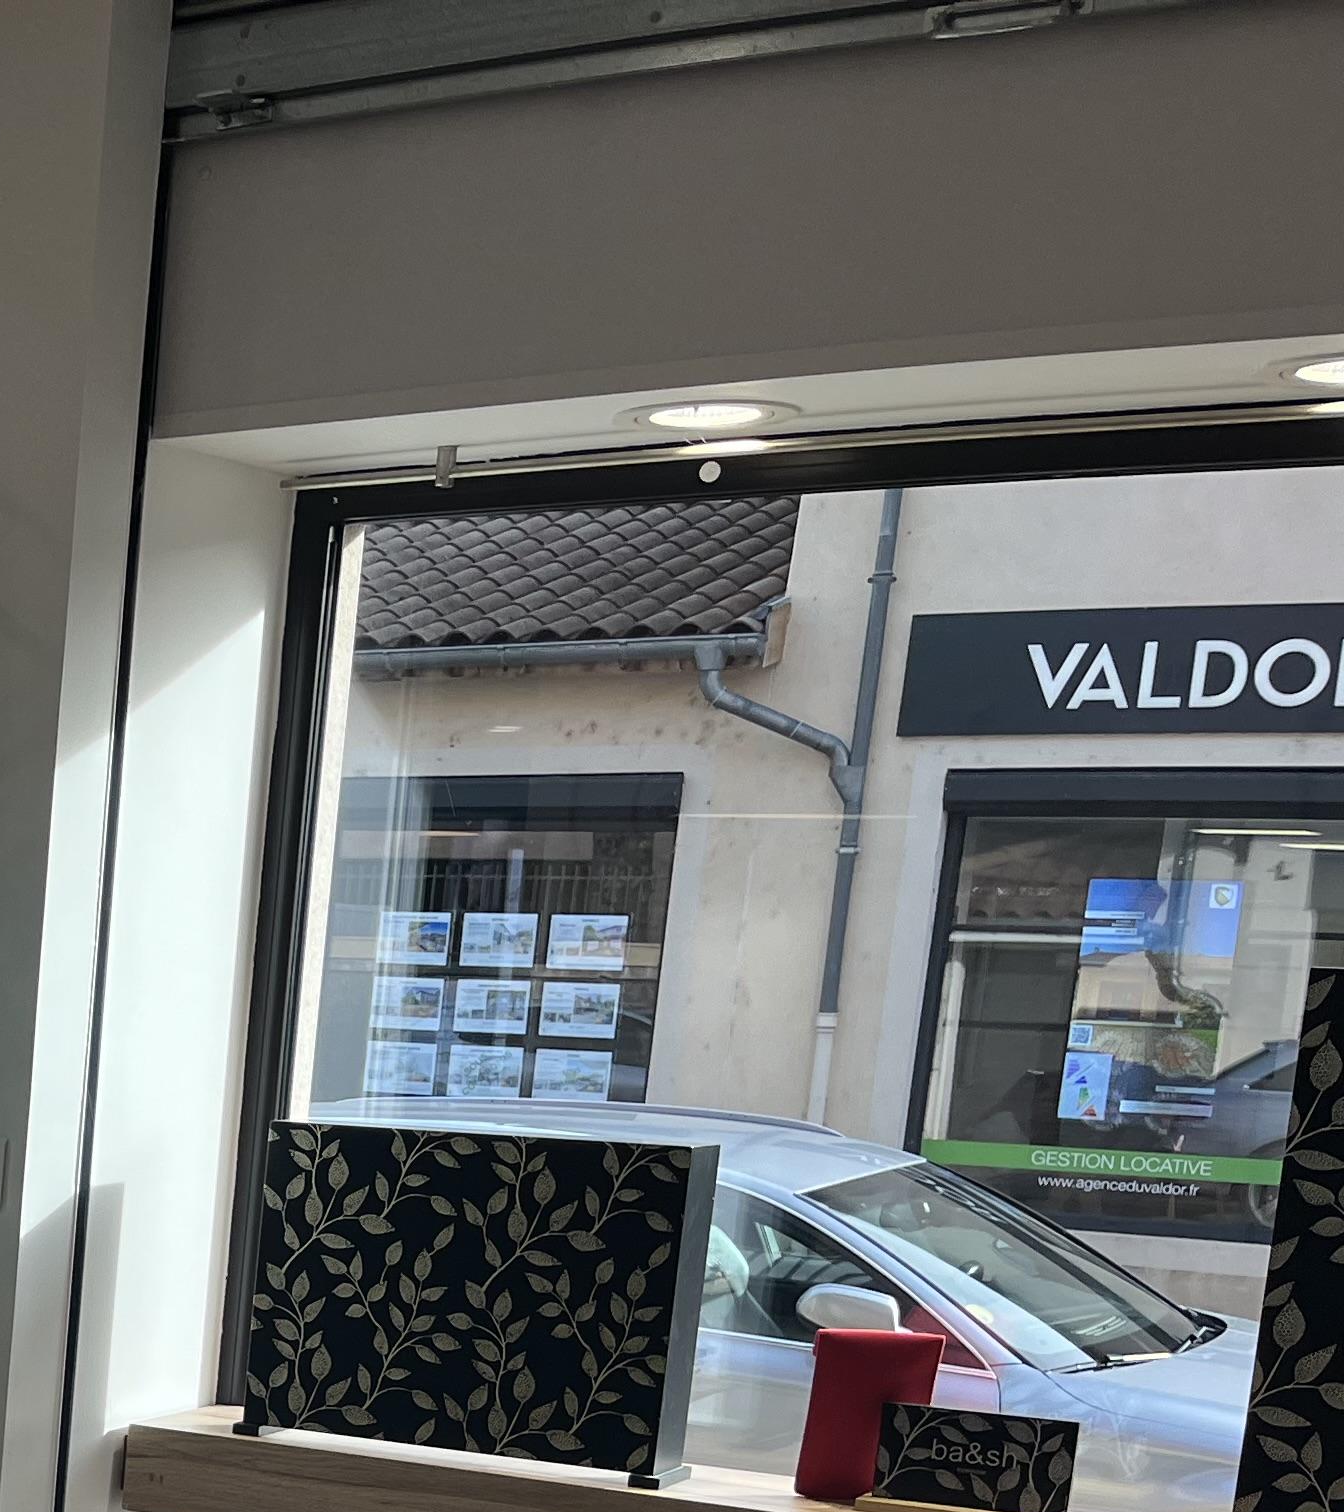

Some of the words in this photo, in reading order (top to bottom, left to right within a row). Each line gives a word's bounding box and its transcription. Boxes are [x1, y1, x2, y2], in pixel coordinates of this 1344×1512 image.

[1026, 637, 1344, 711] VALDO
[1031, 1150, 1114, 1171] GESTION
[1120, 1152, 1213, 1177] LOCATIVE
[1038, 1175, 1200, 1197] www.agenceduvaldor.fr
[931, 1438, 1017, 1469] ba&sh
